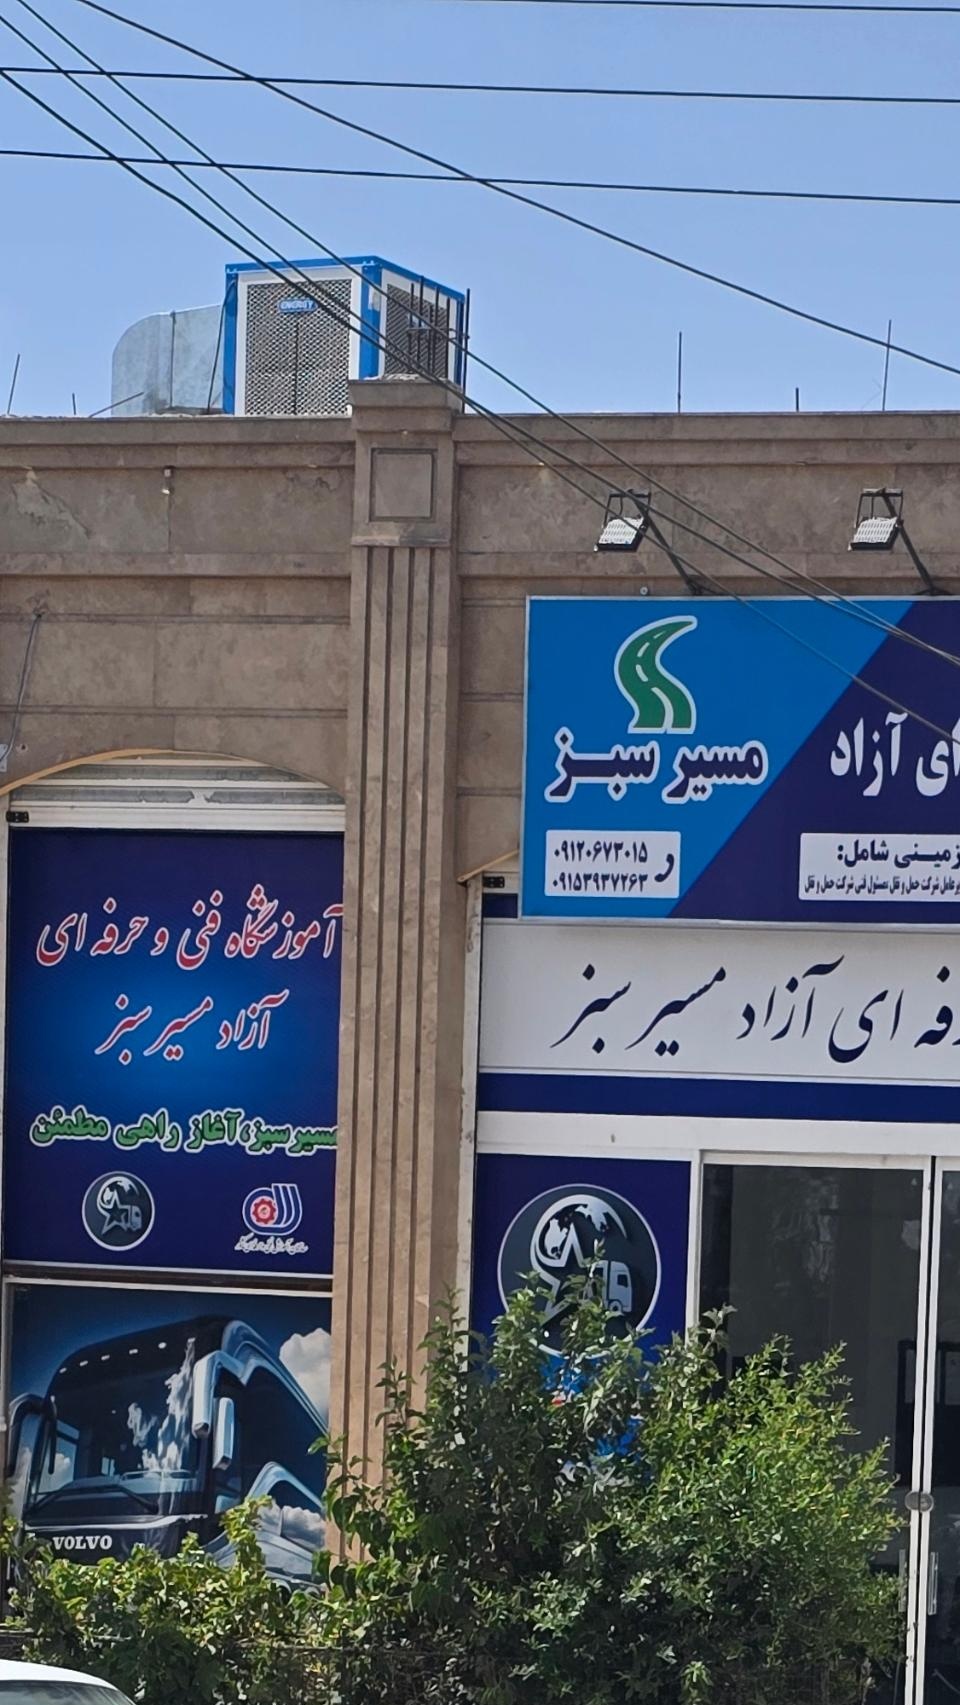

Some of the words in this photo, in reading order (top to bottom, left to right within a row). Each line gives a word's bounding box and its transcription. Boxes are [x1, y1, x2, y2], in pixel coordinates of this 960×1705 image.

[544, 727, 660, 804] سبز
[661, 738, 770, 803] مسیر
[828, 713, 908, 799] آزاد
[554, 840, 648, 862] ۰۹۱۲۰۶۷۳۰۱۵
[837, 839, 889, 867] شامل:
[553, 872, 648, 892] ۰۹۱۵۳۹۳۷۲۶۳
[804, 875, 815, 893] نقل
[820, 874, 835, 894] حمل
[835, 874, 854, 895] شرکت
[906, 875, 920, 895] حمل
[920, 875, 939, 896] شرکت
[36, 907, 87, 966] ای
[91, 898, 149, 958] حرفه
[150, 928, 169, 955] و
[177, 891, 222, 970] فنی
[225, 884, 345, 959] آموزشگاه
[217, 989, 289, 1050] آزاد
[548, 963, 635, 1055] سبز
[625, 966, 729, 1058] مسیر
[735, 953, 847, 1044] آزاد
[825, 984, 906, 1066] ای
[96, 994, 152, 1064] سبز
[145, 997, 213, 1061] مسیر
[30, 1105, 111, 1147] مطمئن
[113, 1108, 182, 1152] راهی
[286, 1126, 338, 1157] سیر
[52, 1535, 112, 1550] VOLVO
